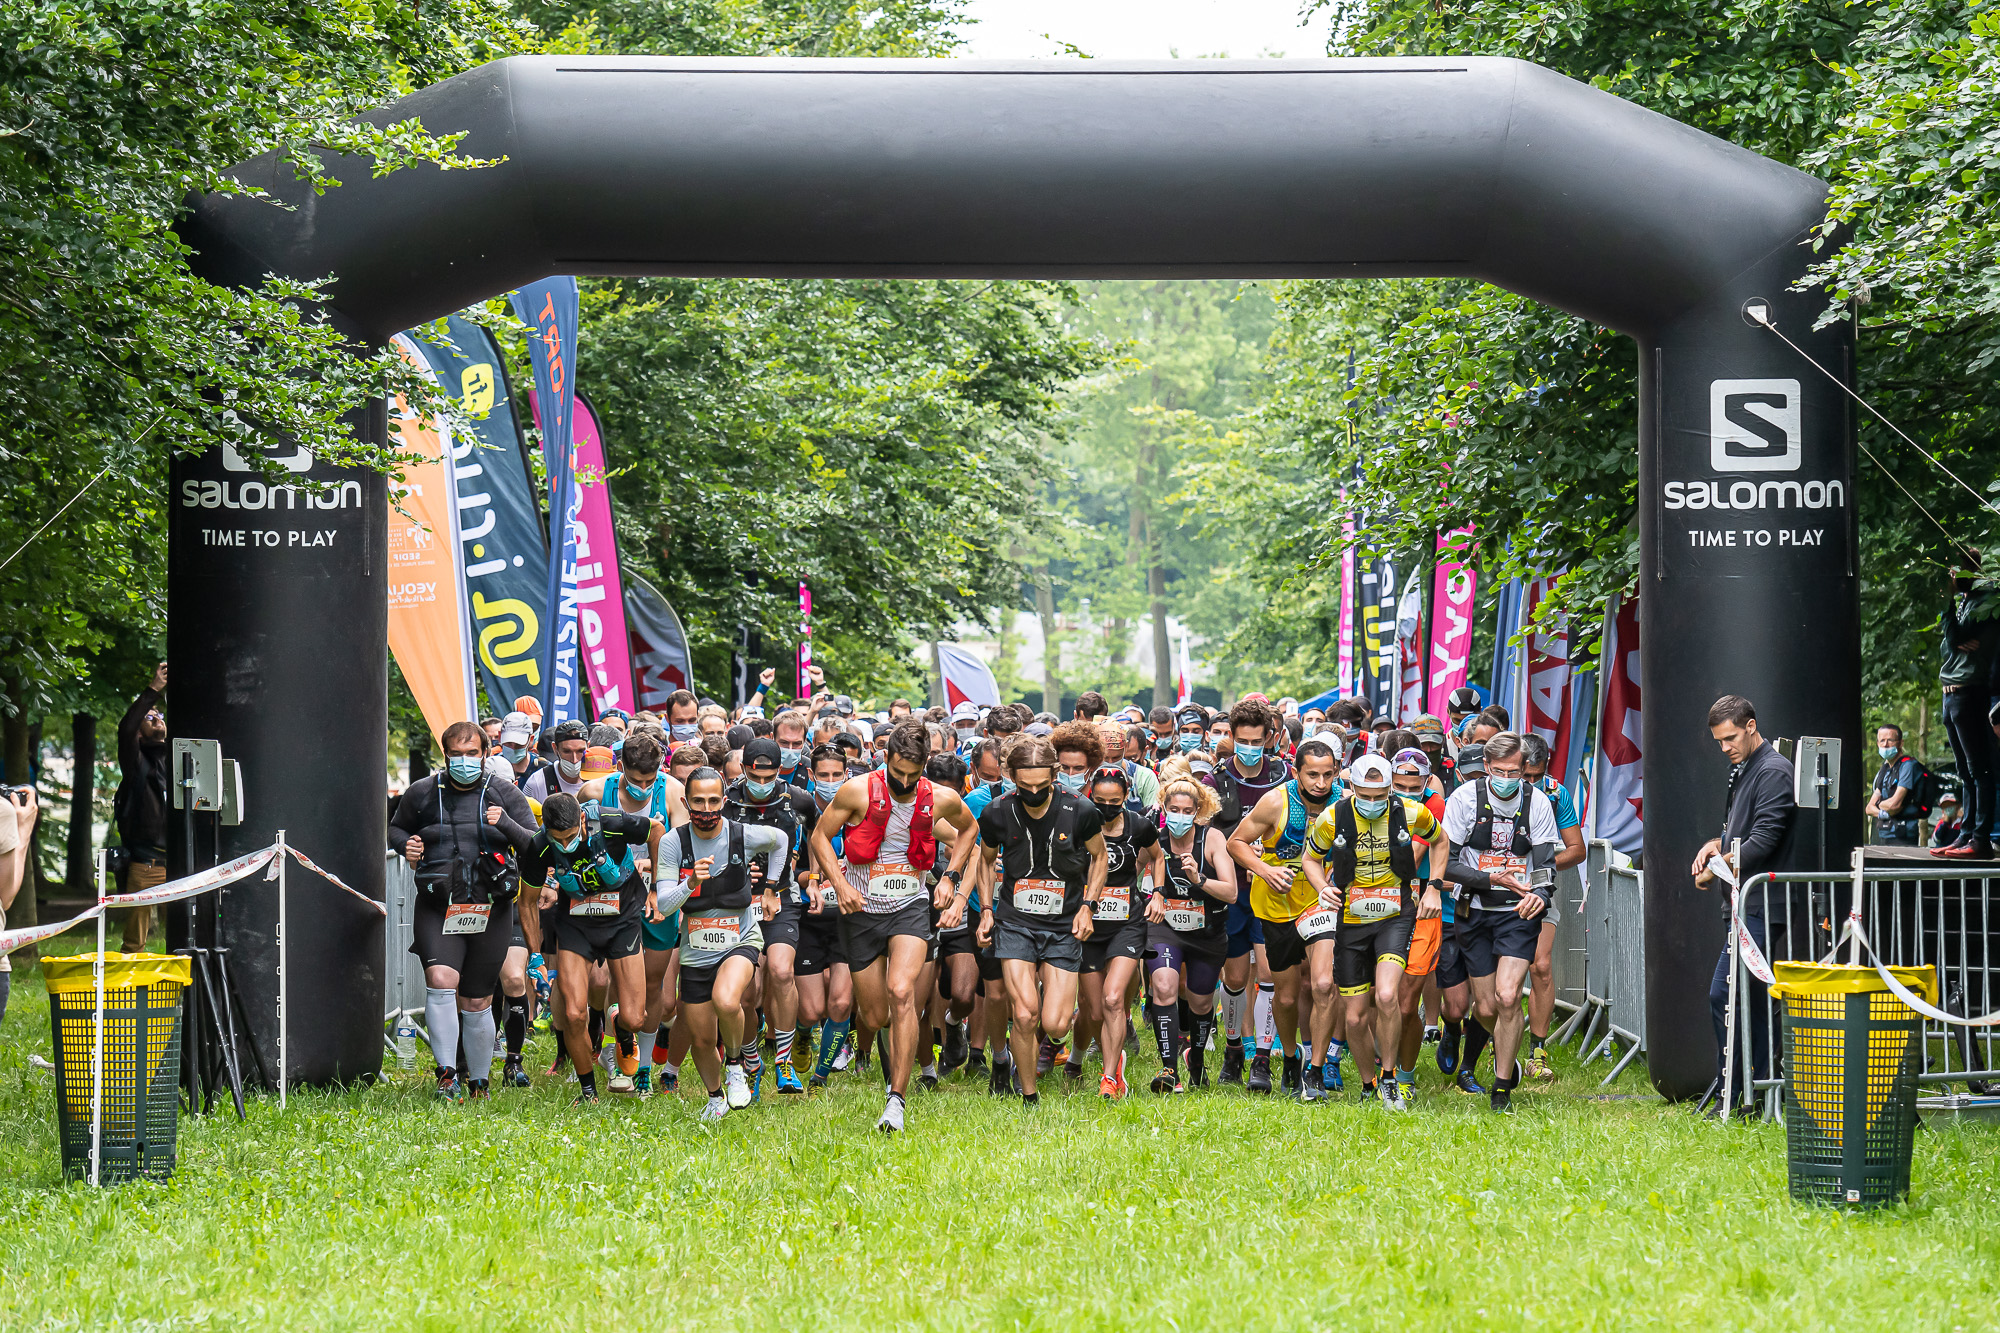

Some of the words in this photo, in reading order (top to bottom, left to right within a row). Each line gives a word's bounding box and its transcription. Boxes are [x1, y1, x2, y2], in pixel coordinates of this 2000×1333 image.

[201, 529, 246, 547] TIME
[252, 530, 281, 547] TO
[288, 529, 338, 547] PLAY
[1688, 530, 1737, 547] TIME
[1743, 530, 1772, 547] TO
[1779, 529, 1825, 546] PLAY
[883, 878, 907, 890] 4006
[824, 891, 835, 902] 45
[1027, 894, 1050, 906] 4792
[1100, 901, 1118, 912] 262
[1364, 902, 1386, 913] 4007
[457, 917, 477, 926] 4074
[1172, 913, 1191, 924] 4351
[1309, 914, 1331, 928] 4004
[702, 932, 726, 943] 4005
[1157, 1015, 1172, 1058] Kalenji
[823, 1030, 844, 1066] Kalenji
